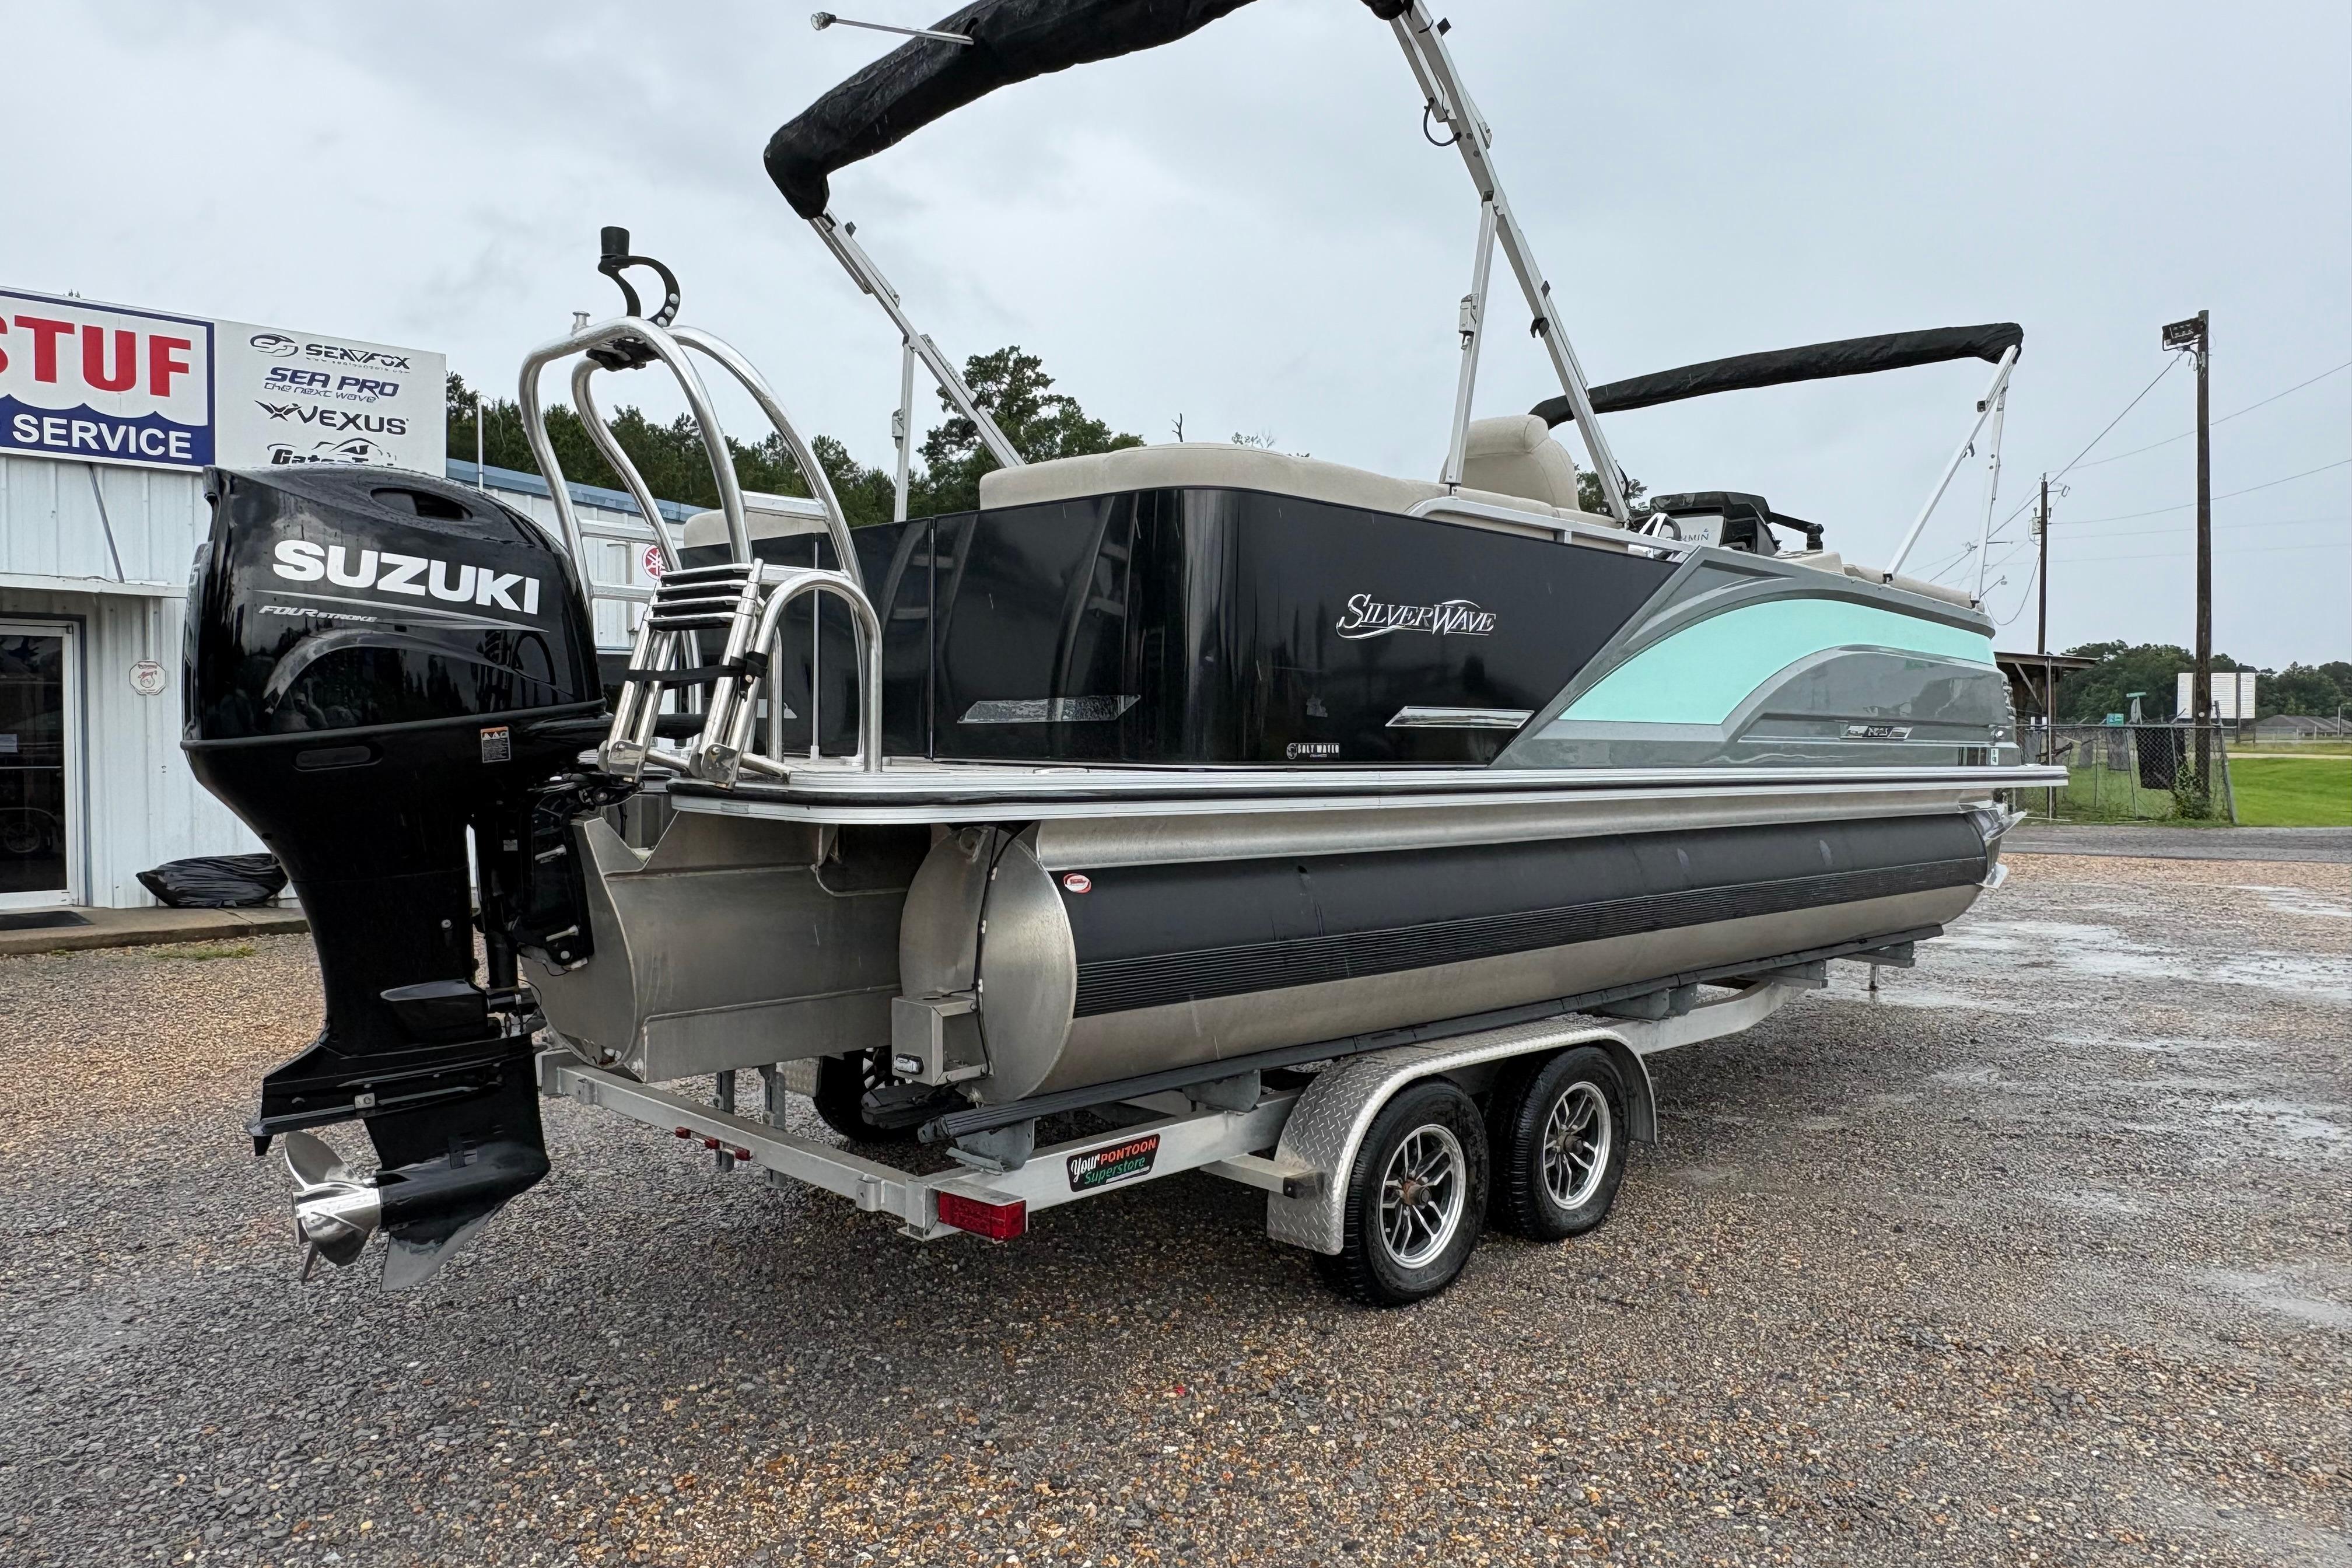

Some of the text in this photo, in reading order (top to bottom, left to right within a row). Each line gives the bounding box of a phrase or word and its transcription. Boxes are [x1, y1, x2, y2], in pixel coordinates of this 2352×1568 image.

[0, 315, 191, 397] TUF
[264, 367, 400, 398] SEA PRO
[12, 414, 192, 459] SERVICE
[296, 405, 407, 435] VEXUS
[272, 540, 540, 615] SUZUKI
[1070, 1137, 1156, 1183] Your PONTOON
[1084, 1157, 1146, 1184] Superstore
